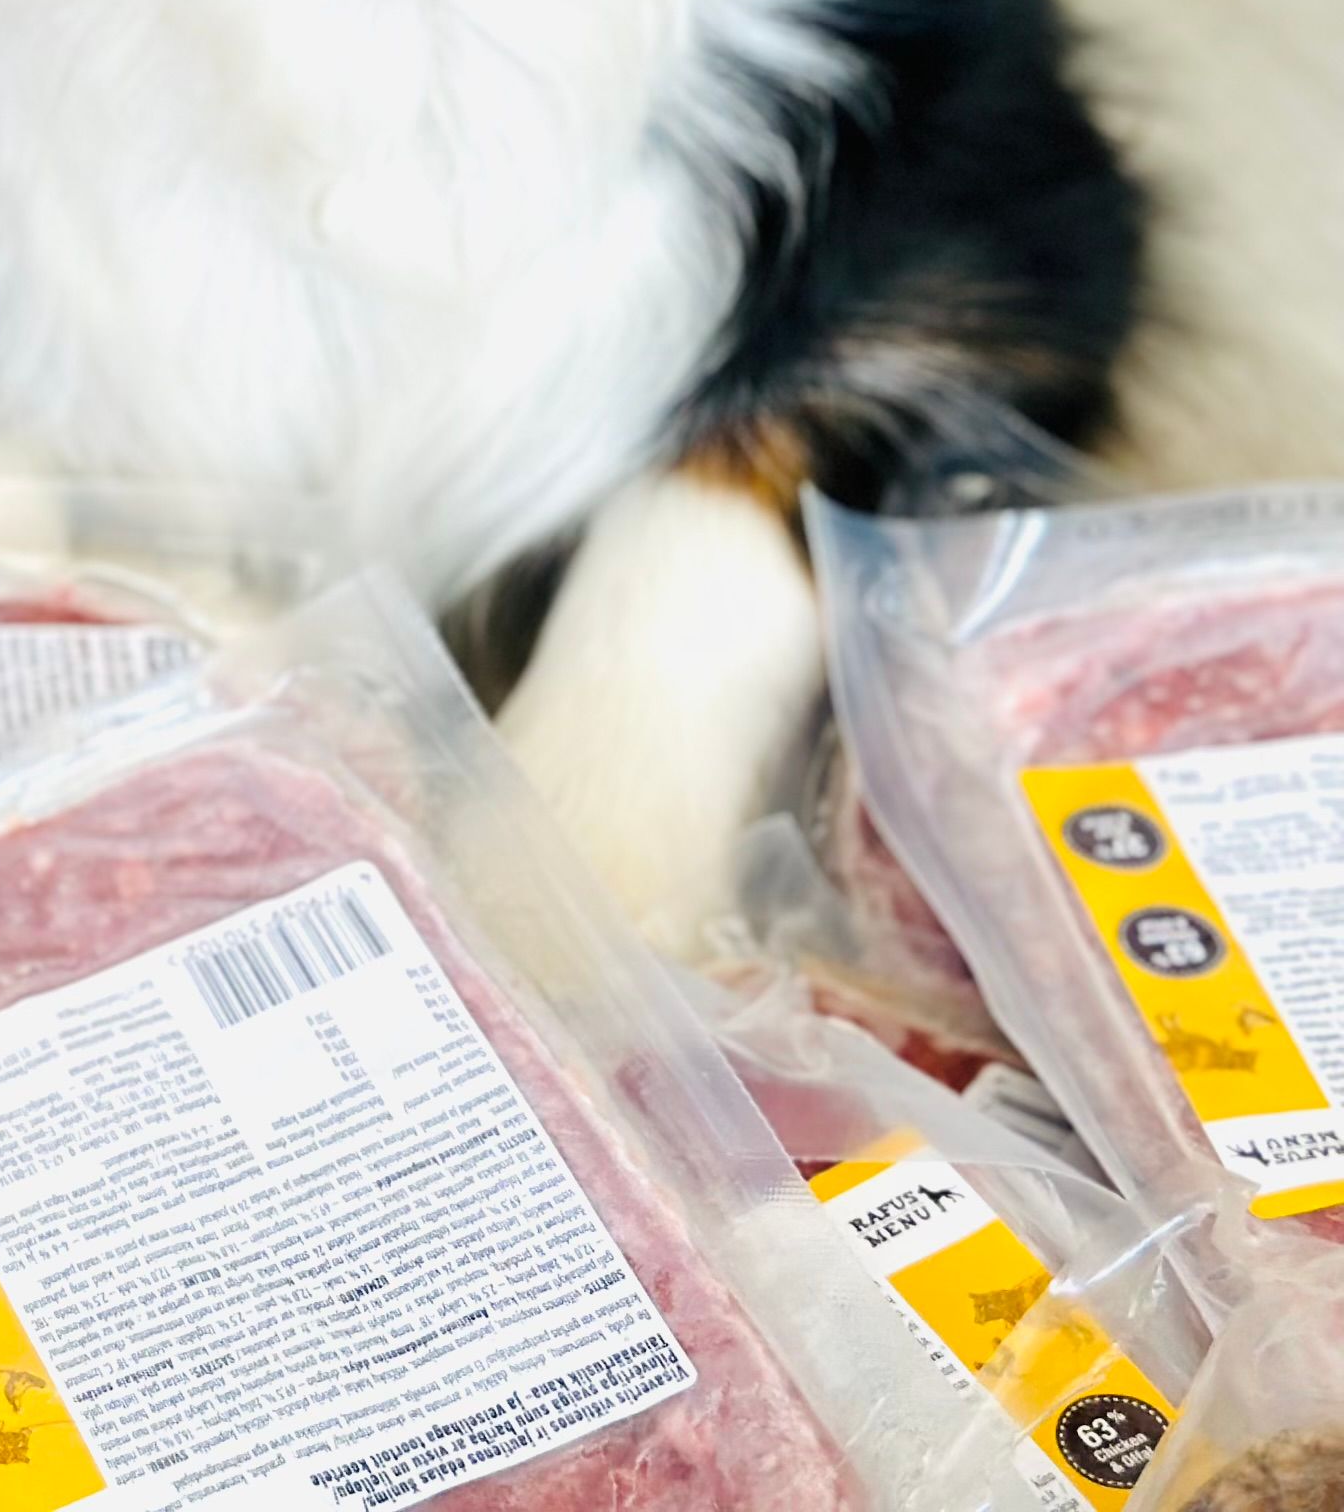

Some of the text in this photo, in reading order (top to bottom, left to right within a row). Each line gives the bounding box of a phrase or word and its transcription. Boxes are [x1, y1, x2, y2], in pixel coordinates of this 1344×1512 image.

[1265, 1129, 1340, 1150] MENU
[848, 1190, 918, 1232] RAFUS
[864, 1206, 931, 1248] MENU
[440, 1307, 488, 1334] Analitinės
[637, 1308, 652, 1320] Be
[372, 1331, 438, 1364] sudedamosios
[310, 1334, 668, 1488] Täisväärtuslik kana- ja veiselihaga toortoit koertele
[333, 1344, 678, 1504] Pilnvērtīga svaigā suņu barība ar vistu un liellopu/
[1076, 1408, 1126, 1448] 63%
[363, 1364, 688, 1512] Visavertis vištienos ir jautienos ėdalas šunims/
[1093, 1431, 1149, 1463] Chicken
[1109, 1460, 1126, 1475] &
